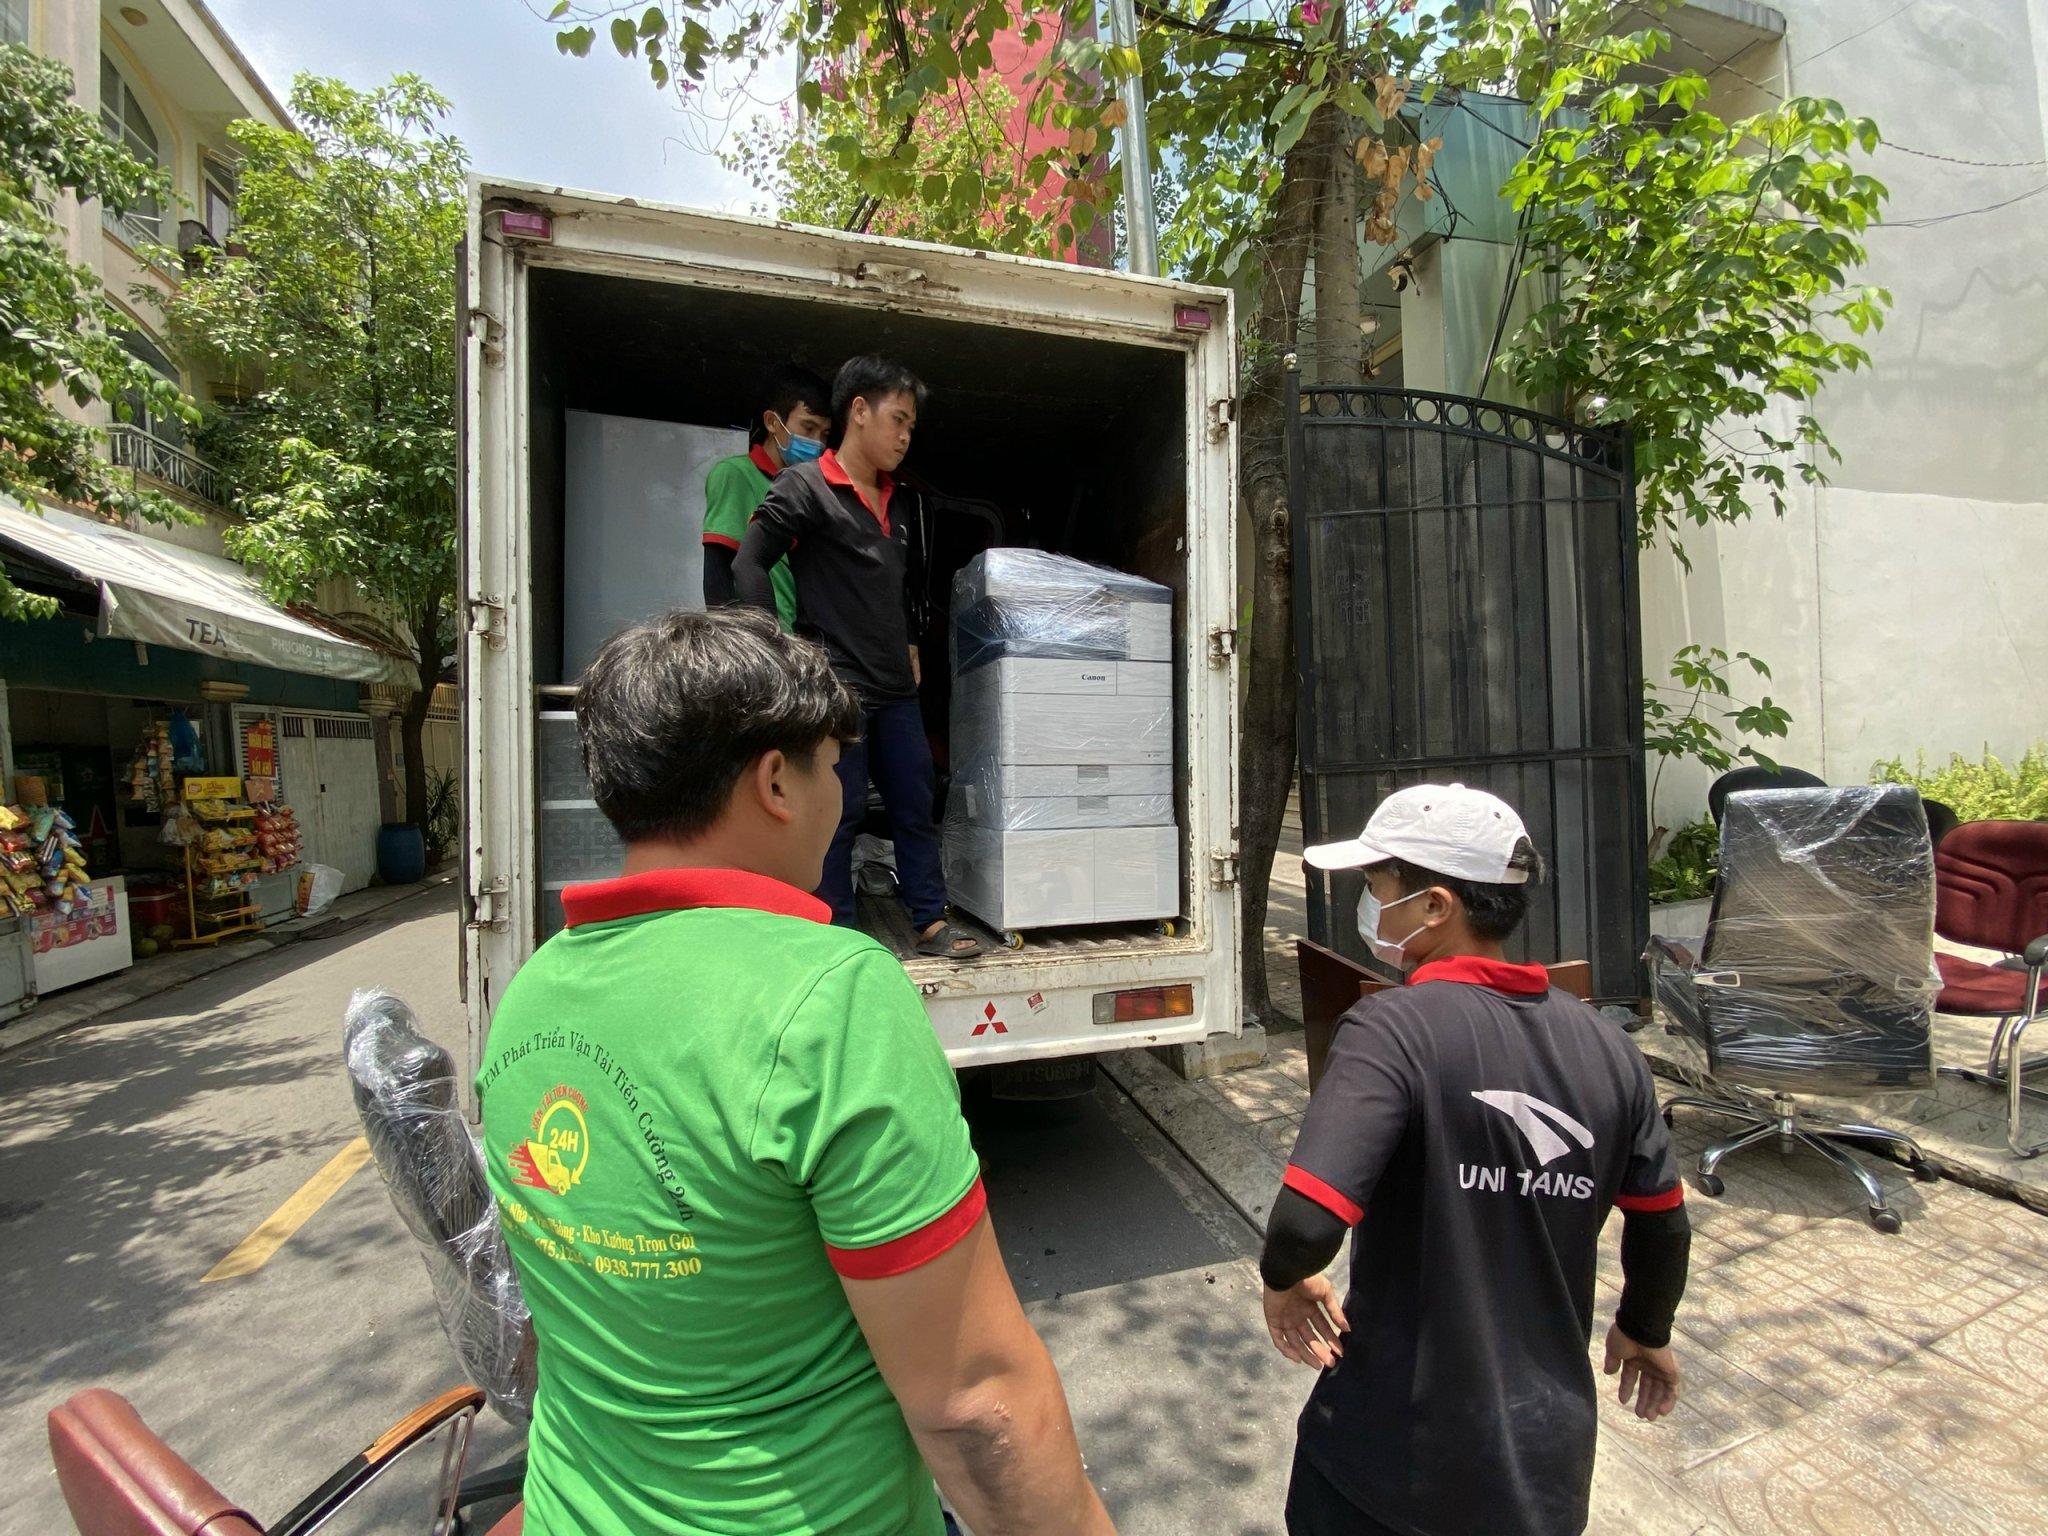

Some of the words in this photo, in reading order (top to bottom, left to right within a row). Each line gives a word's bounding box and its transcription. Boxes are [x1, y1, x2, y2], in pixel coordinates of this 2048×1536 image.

[186, 618, 227, 648] TEA
[502, 1040, 531, 1069] Phát
[533, 1026, 566, 1052] Triển
[570, 1030, 591, 1058] Vận
[593, 1044, 615, 1076] Tải
[612, 1067, 639, 1113] Tiến
[637, 1112, 676, 1185] Cường
[549, 1128, 579, 1153] 24H
[1459, 1163, 1506, 1193] UNI
[583, 1225, 601, 1245] Kho
[636, 1235, 668, 1257] Trọn
[669, 1233, 696, 1251] Gói
[595, 1255, 702, 1279] 0938.777.300
